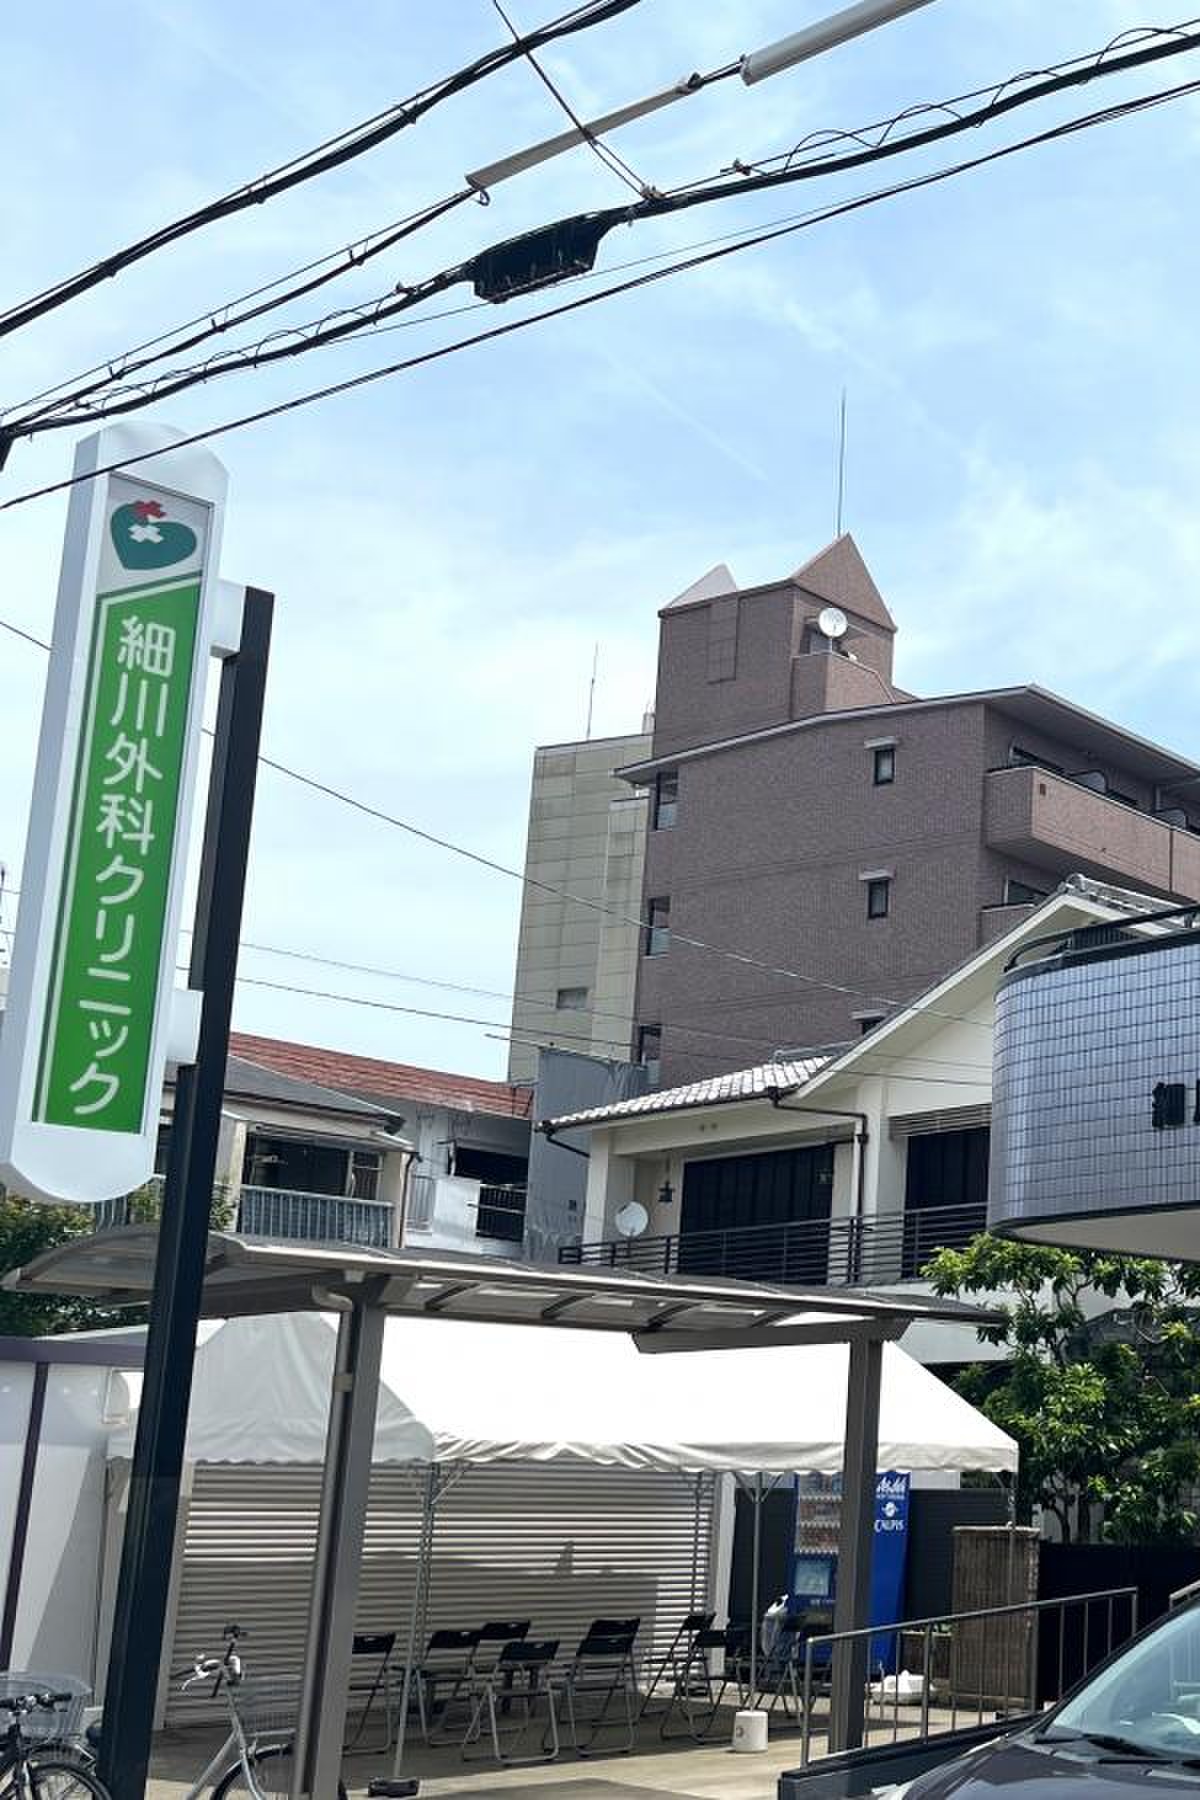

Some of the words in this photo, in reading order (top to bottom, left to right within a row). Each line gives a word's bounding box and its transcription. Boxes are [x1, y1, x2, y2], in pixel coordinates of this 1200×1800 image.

[69, 615, 175, 1115] 細川外科クリニック
